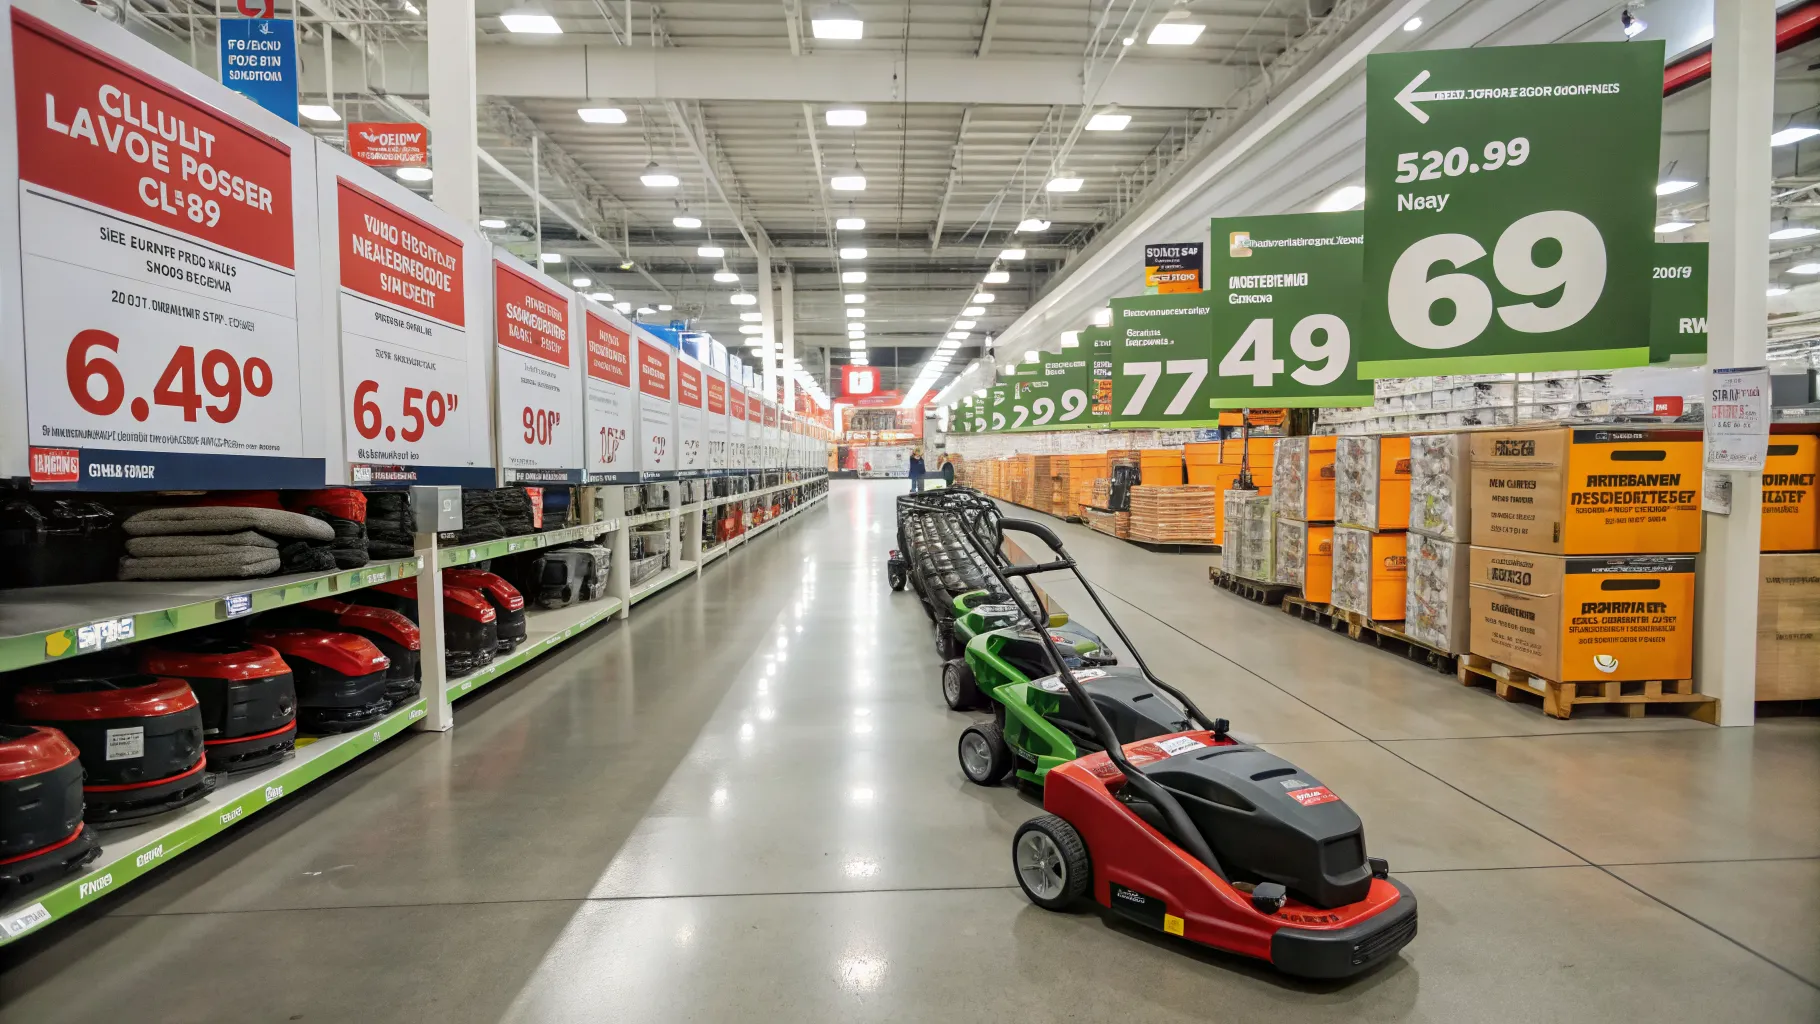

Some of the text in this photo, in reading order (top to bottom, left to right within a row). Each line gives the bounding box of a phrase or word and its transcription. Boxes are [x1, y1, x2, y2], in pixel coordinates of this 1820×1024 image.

[45, 93, 273, 215] LAVOE POSSER
[1394, 137, 1530, 184] 520.99
[1387, 210, 1608, 350] 69
[1121, 358, 1209, 416] 77
[1218, 313, 1351, 387] 49
